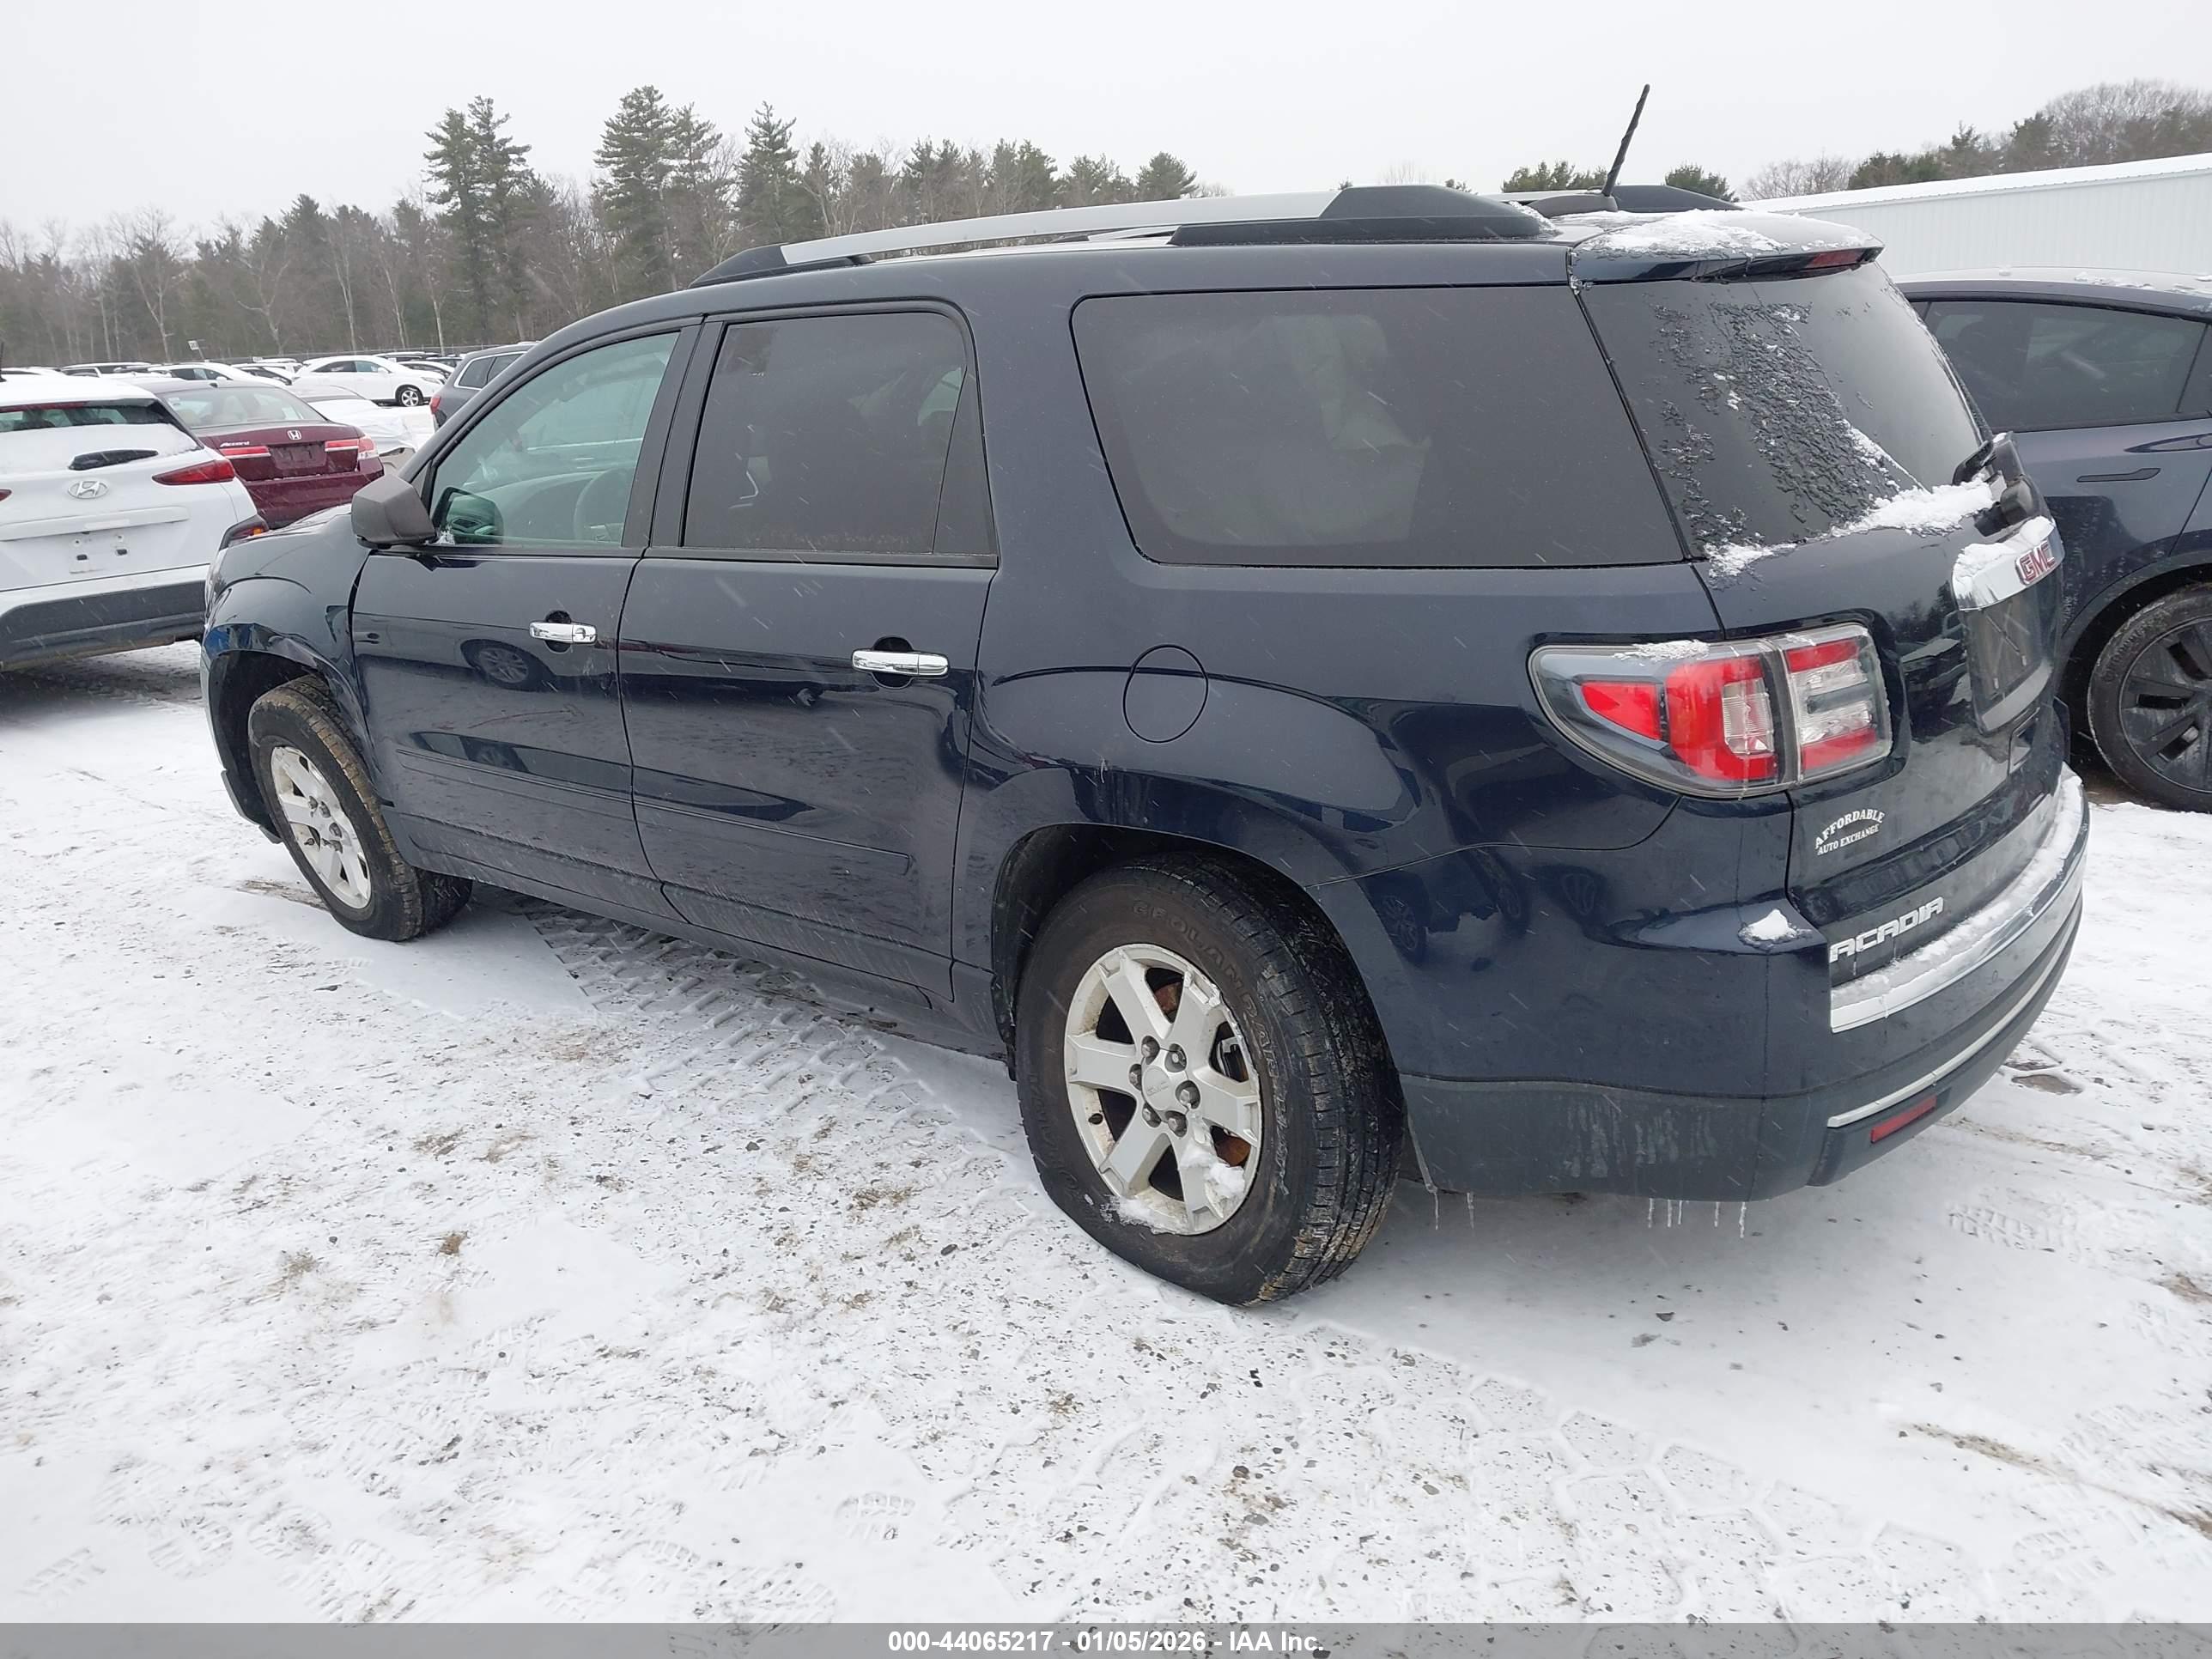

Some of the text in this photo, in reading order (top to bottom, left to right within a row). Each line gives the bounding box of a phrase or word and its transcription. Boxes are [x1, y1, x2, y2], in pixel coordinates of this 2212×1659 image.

[2016, 541, 2055, 584] GMC
[1814, 808, 1885, 849] AFFORDABLE
[1816, 823, 1880, 855] AUTO EXCHANGE
[1828, 896, 1944, 963] ACADIA
